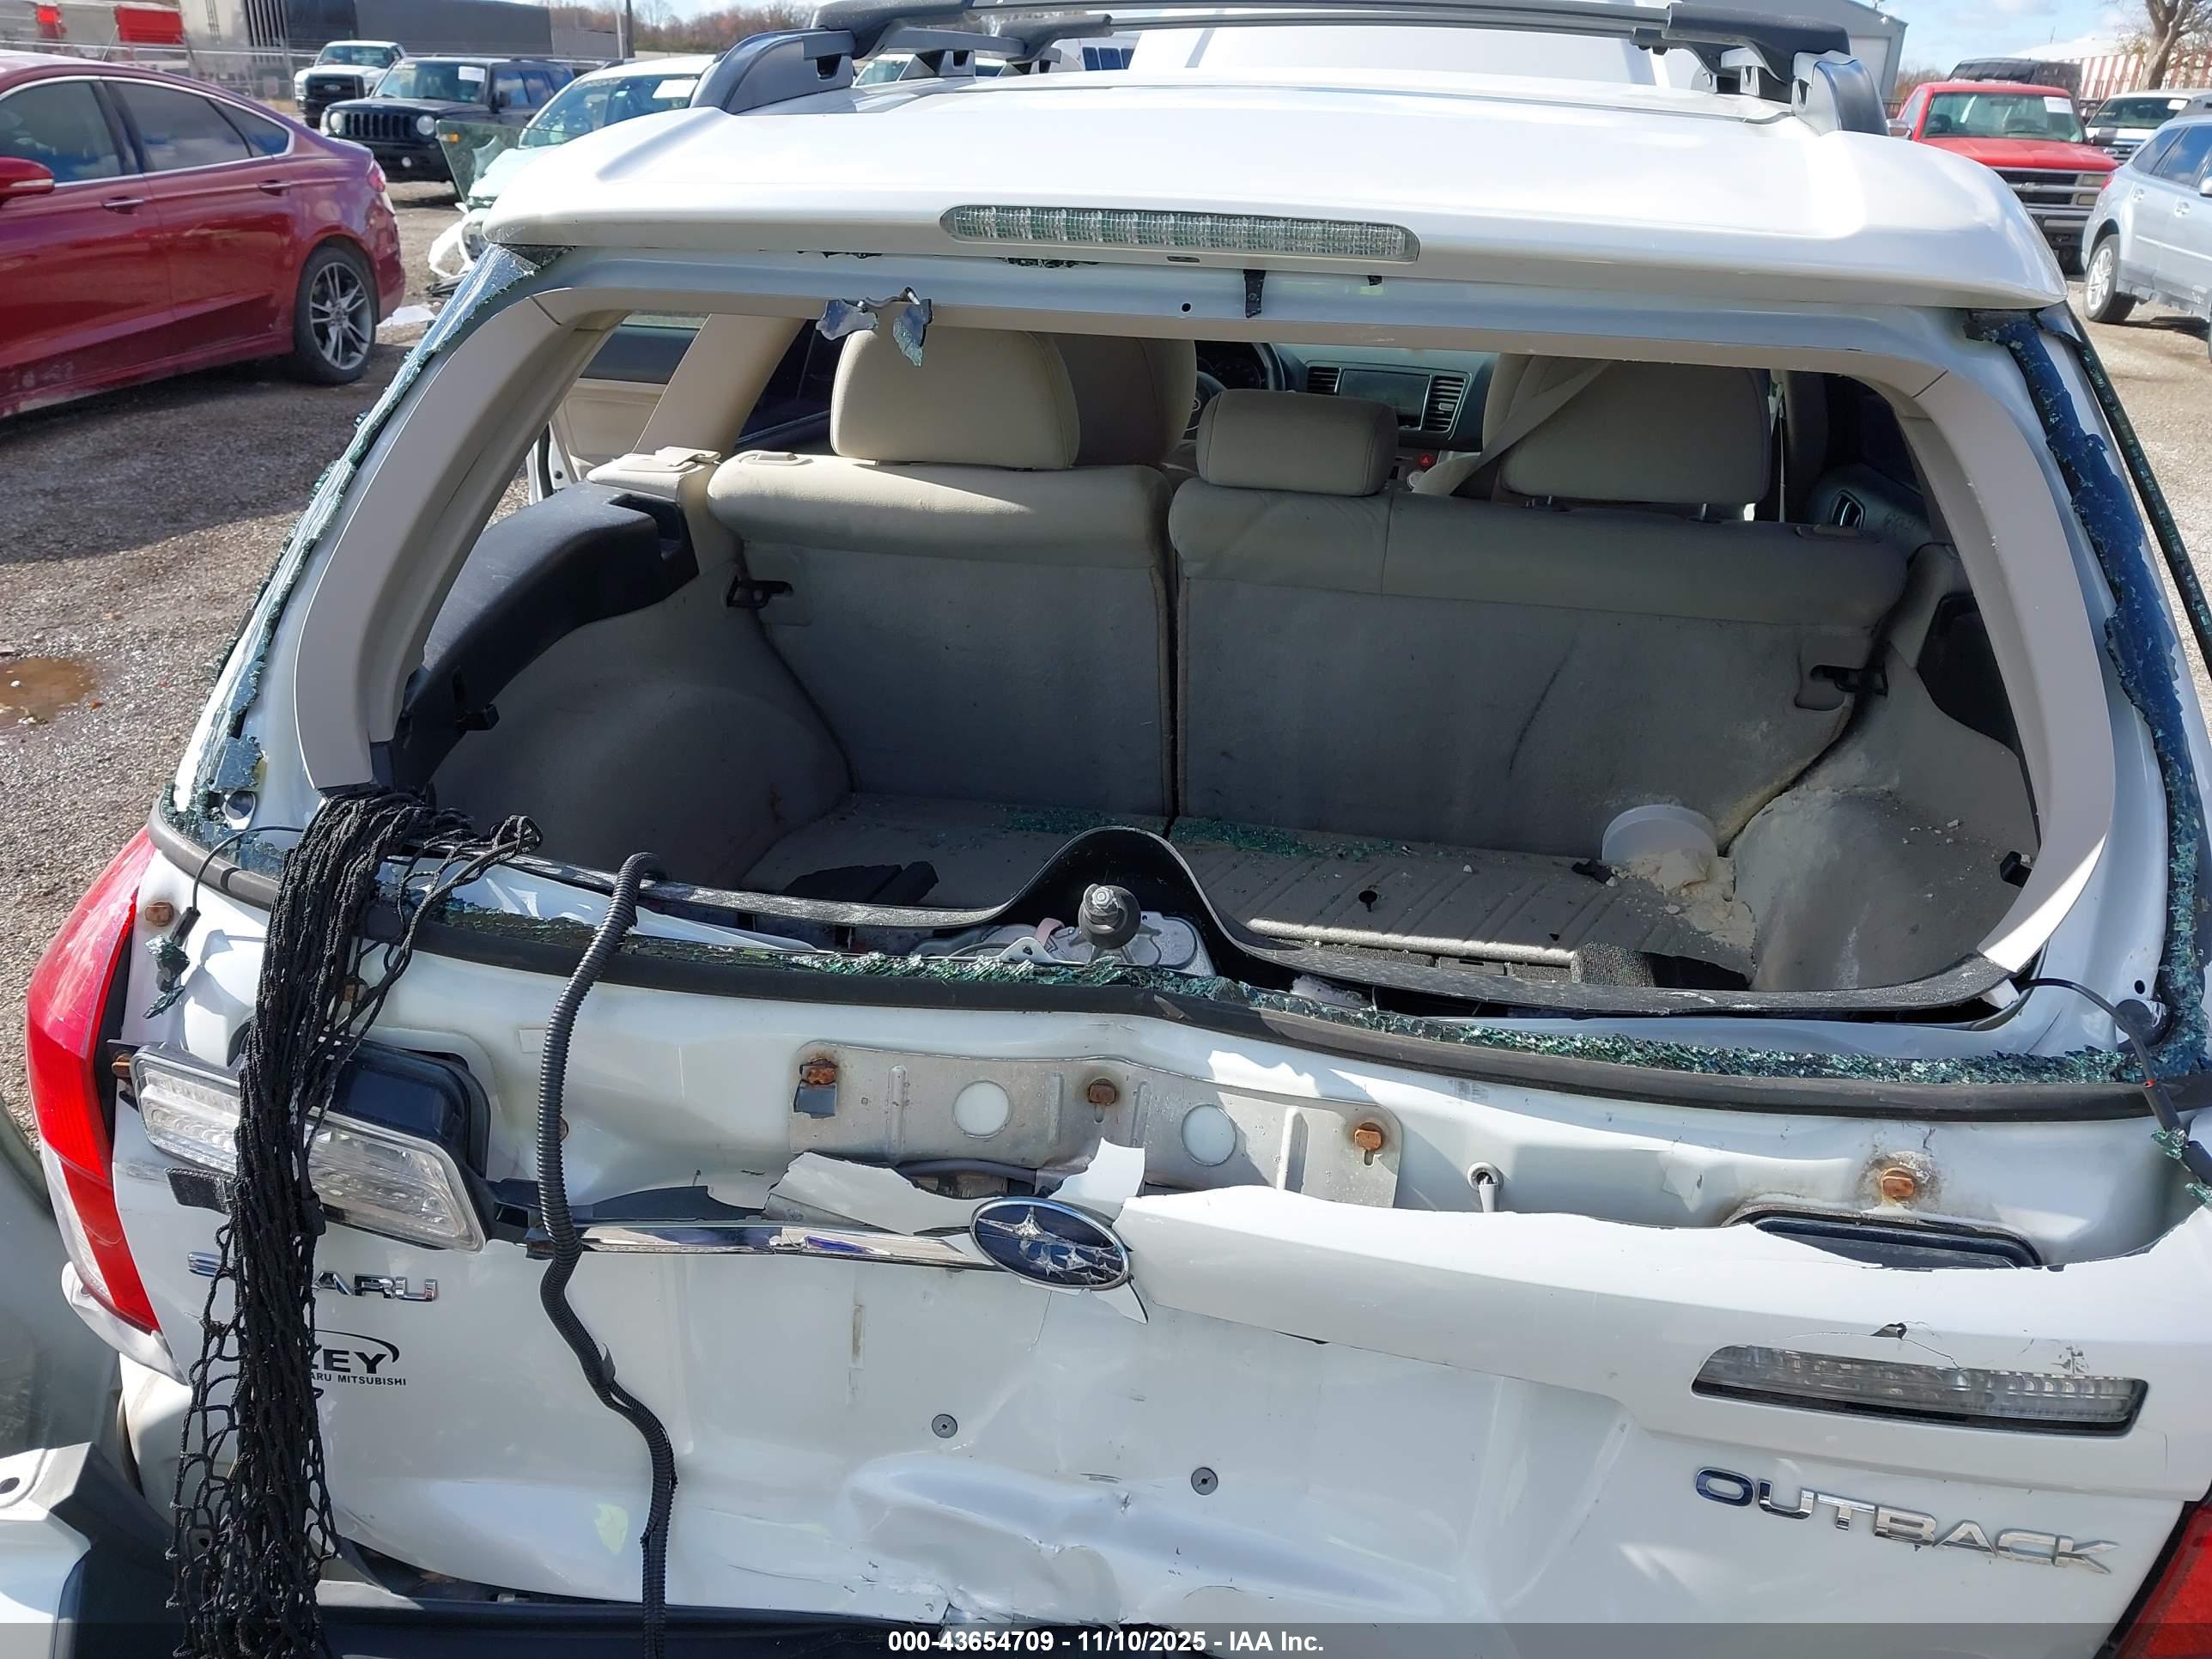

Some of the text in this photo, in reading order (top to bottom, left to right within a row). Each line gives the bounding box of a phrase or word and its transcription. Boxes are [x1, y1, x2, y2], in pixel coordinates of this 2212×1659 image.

[187, 1251, 438, 1302] SARU
[337, 1374, 407, 1386] MITSUBISHI
[1694, 1466, 2120, 1574] OUTBACK
